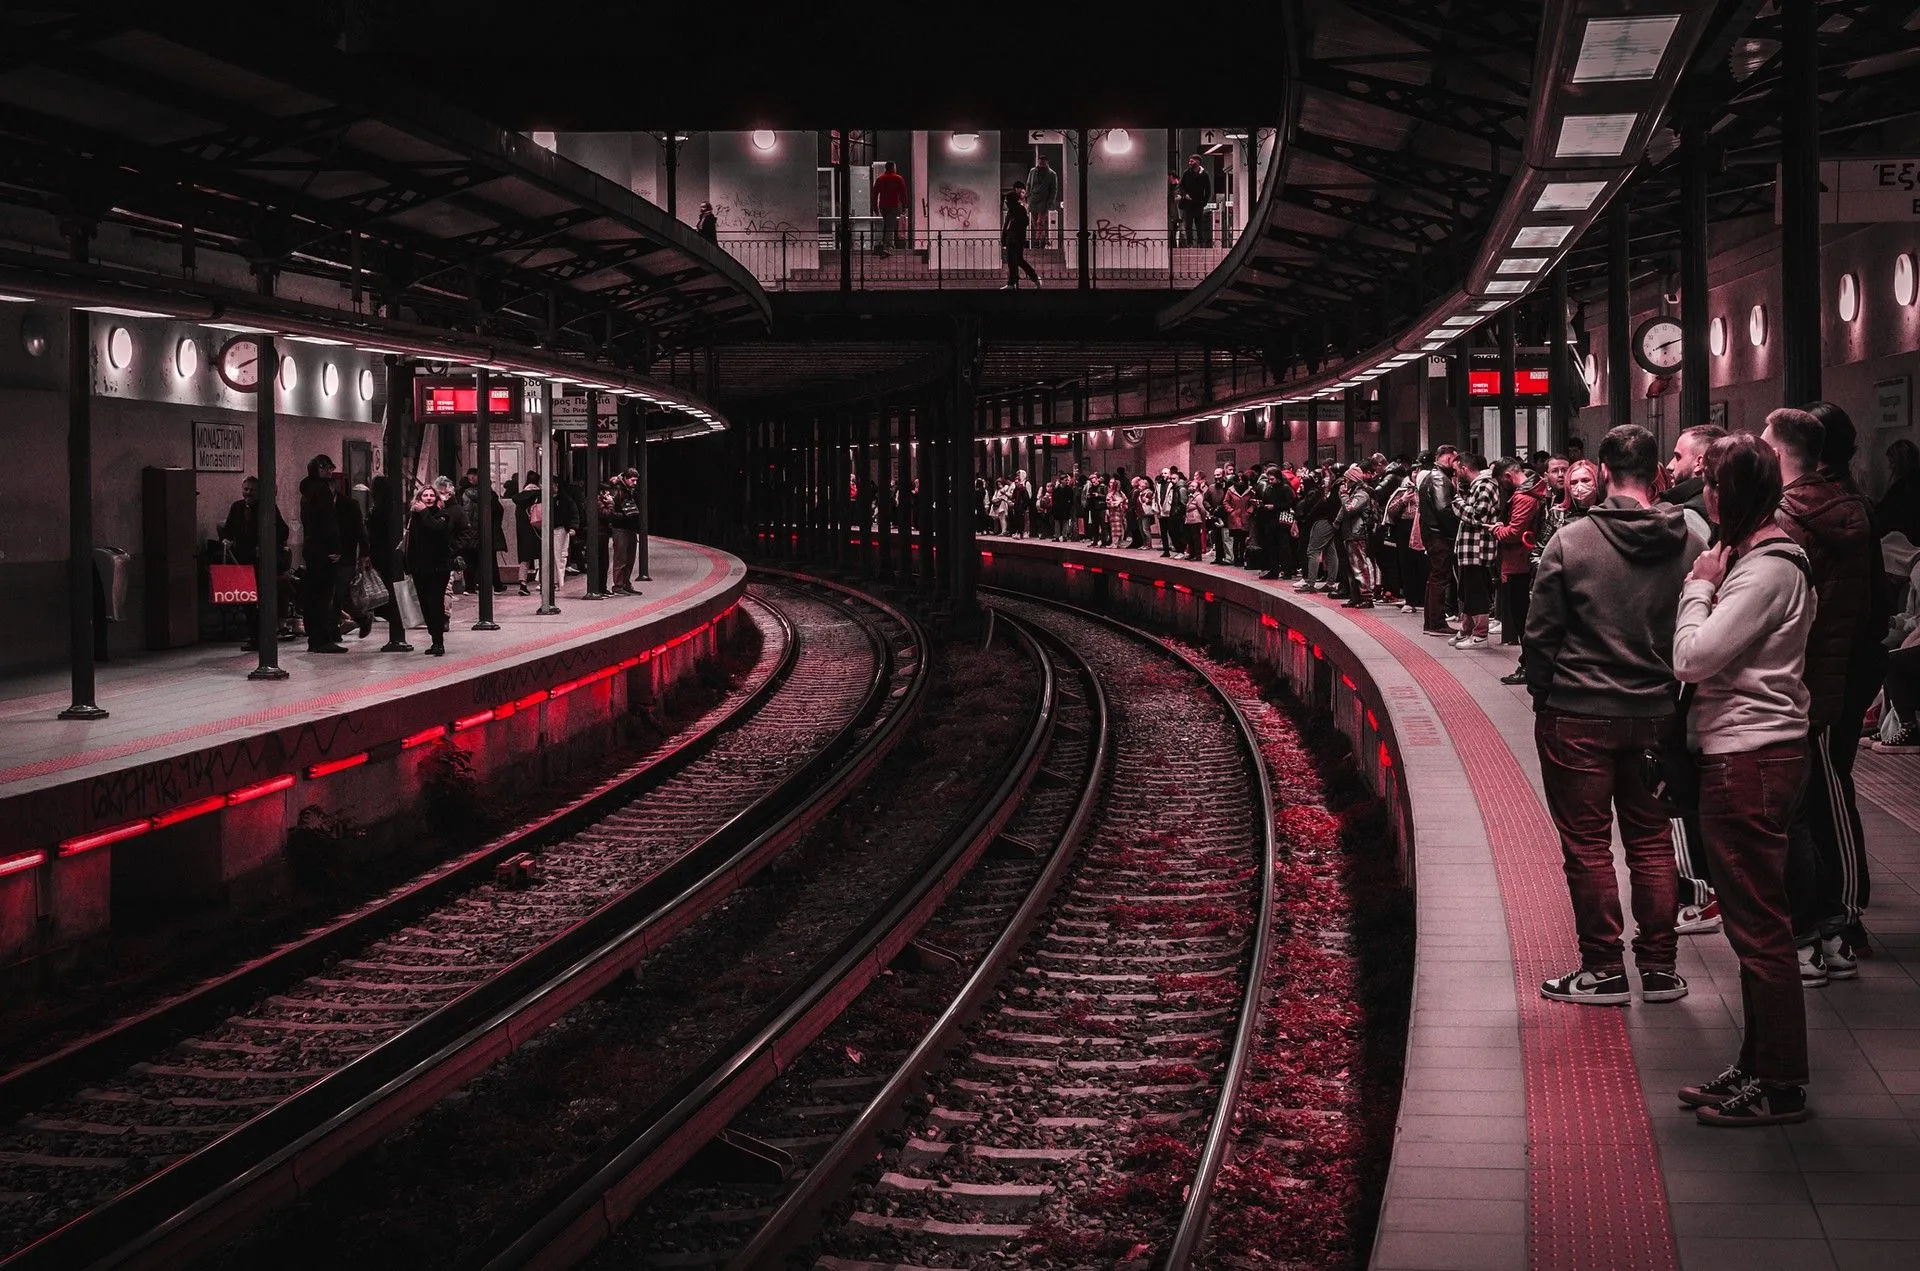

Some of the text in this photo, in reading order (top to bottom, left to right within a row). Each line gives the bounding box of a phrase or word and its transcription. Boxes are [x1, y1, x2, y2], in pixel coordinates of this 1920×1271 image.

[197, 427, 243, 450] ΜΟΝΑΣΤΗΡΙΟΝ
[200, 450, 241, 468] Monastirion
[214, 589, 258, 602] notos
